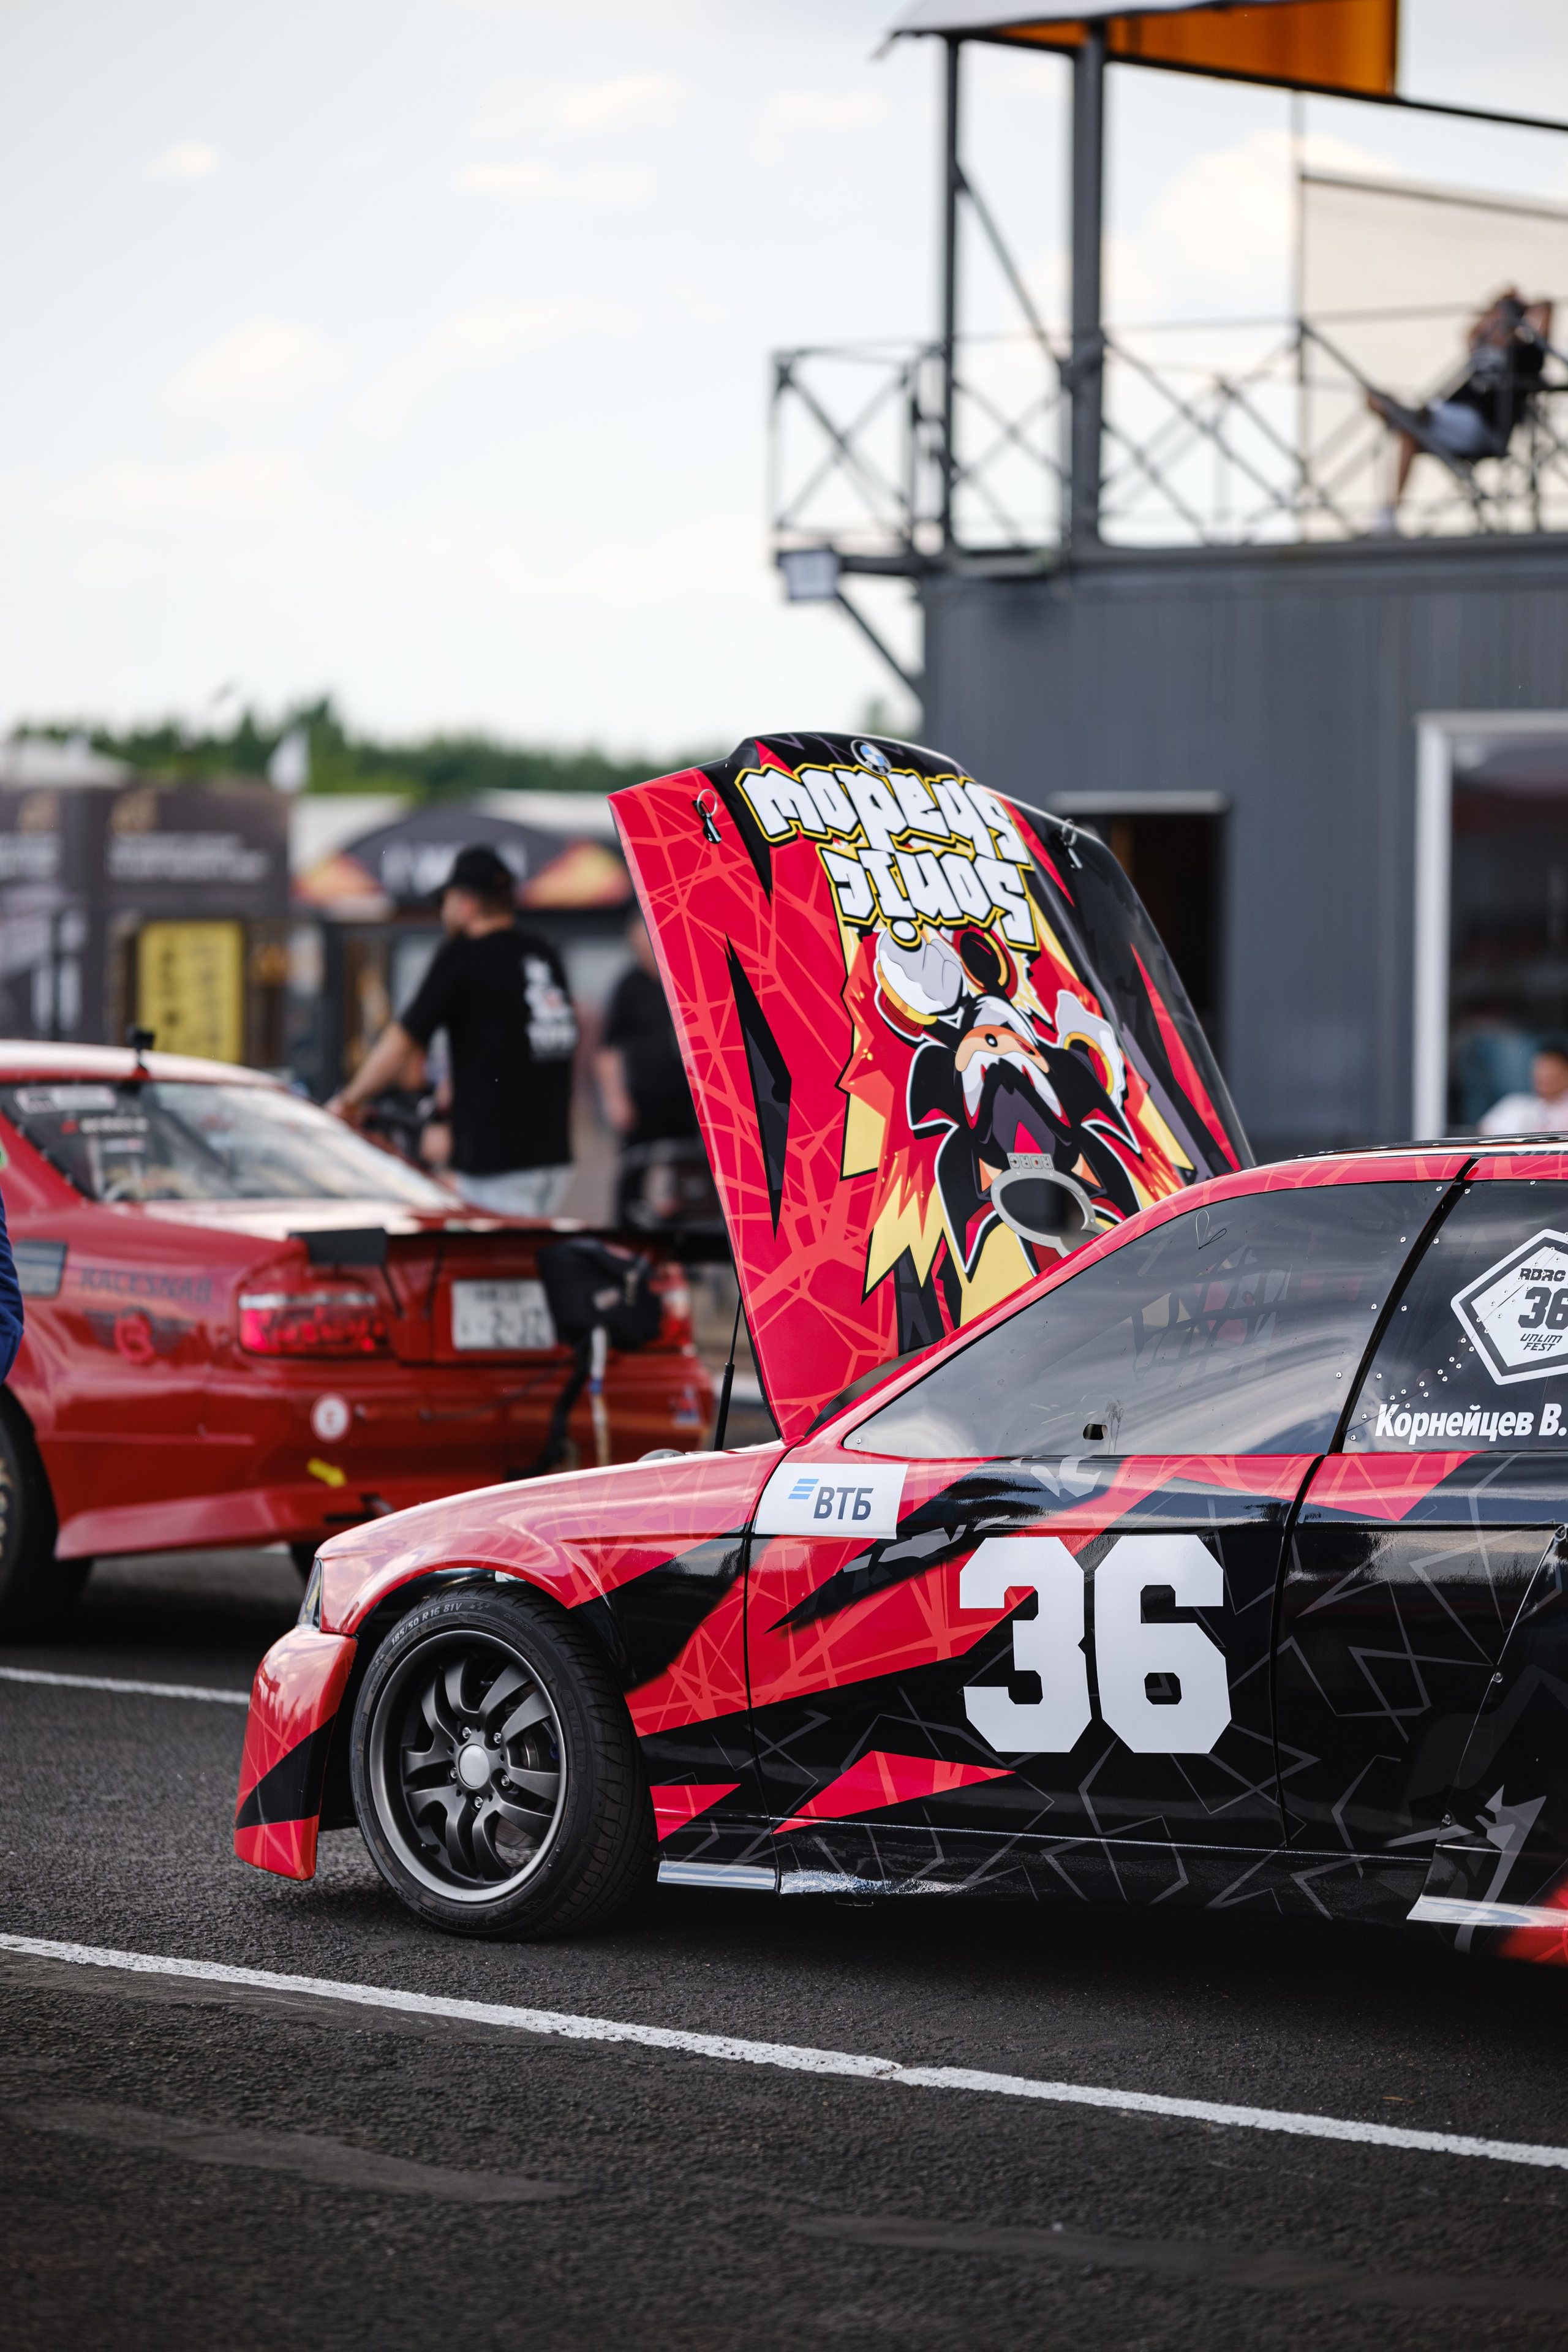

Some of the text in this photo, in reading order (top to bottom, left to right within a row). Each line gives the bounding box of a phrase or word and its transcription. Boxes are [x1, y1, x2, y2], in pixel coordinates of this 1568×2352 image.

[1009, 1155, 1053, 1169] RDRC
[1520, 1268, 1566, 1282] RDRC
[1518, 1287, 1568, 1330] 36
[1520, 1333, 1563, 1343] UNLIM
[1523, 1343, 1556, 1351] FEST
[1374, 1403, 1567, 1445] Корнейцев В.
[813, 1487, 874, 1520] ВТБ
[391, 1617, 419, 1645] 185/50
[443, 1602, 462, 1613] 81V
[503, 1613, 533, 1632] OUTSIDE
[959, 1535, 1232, 1754] 36
